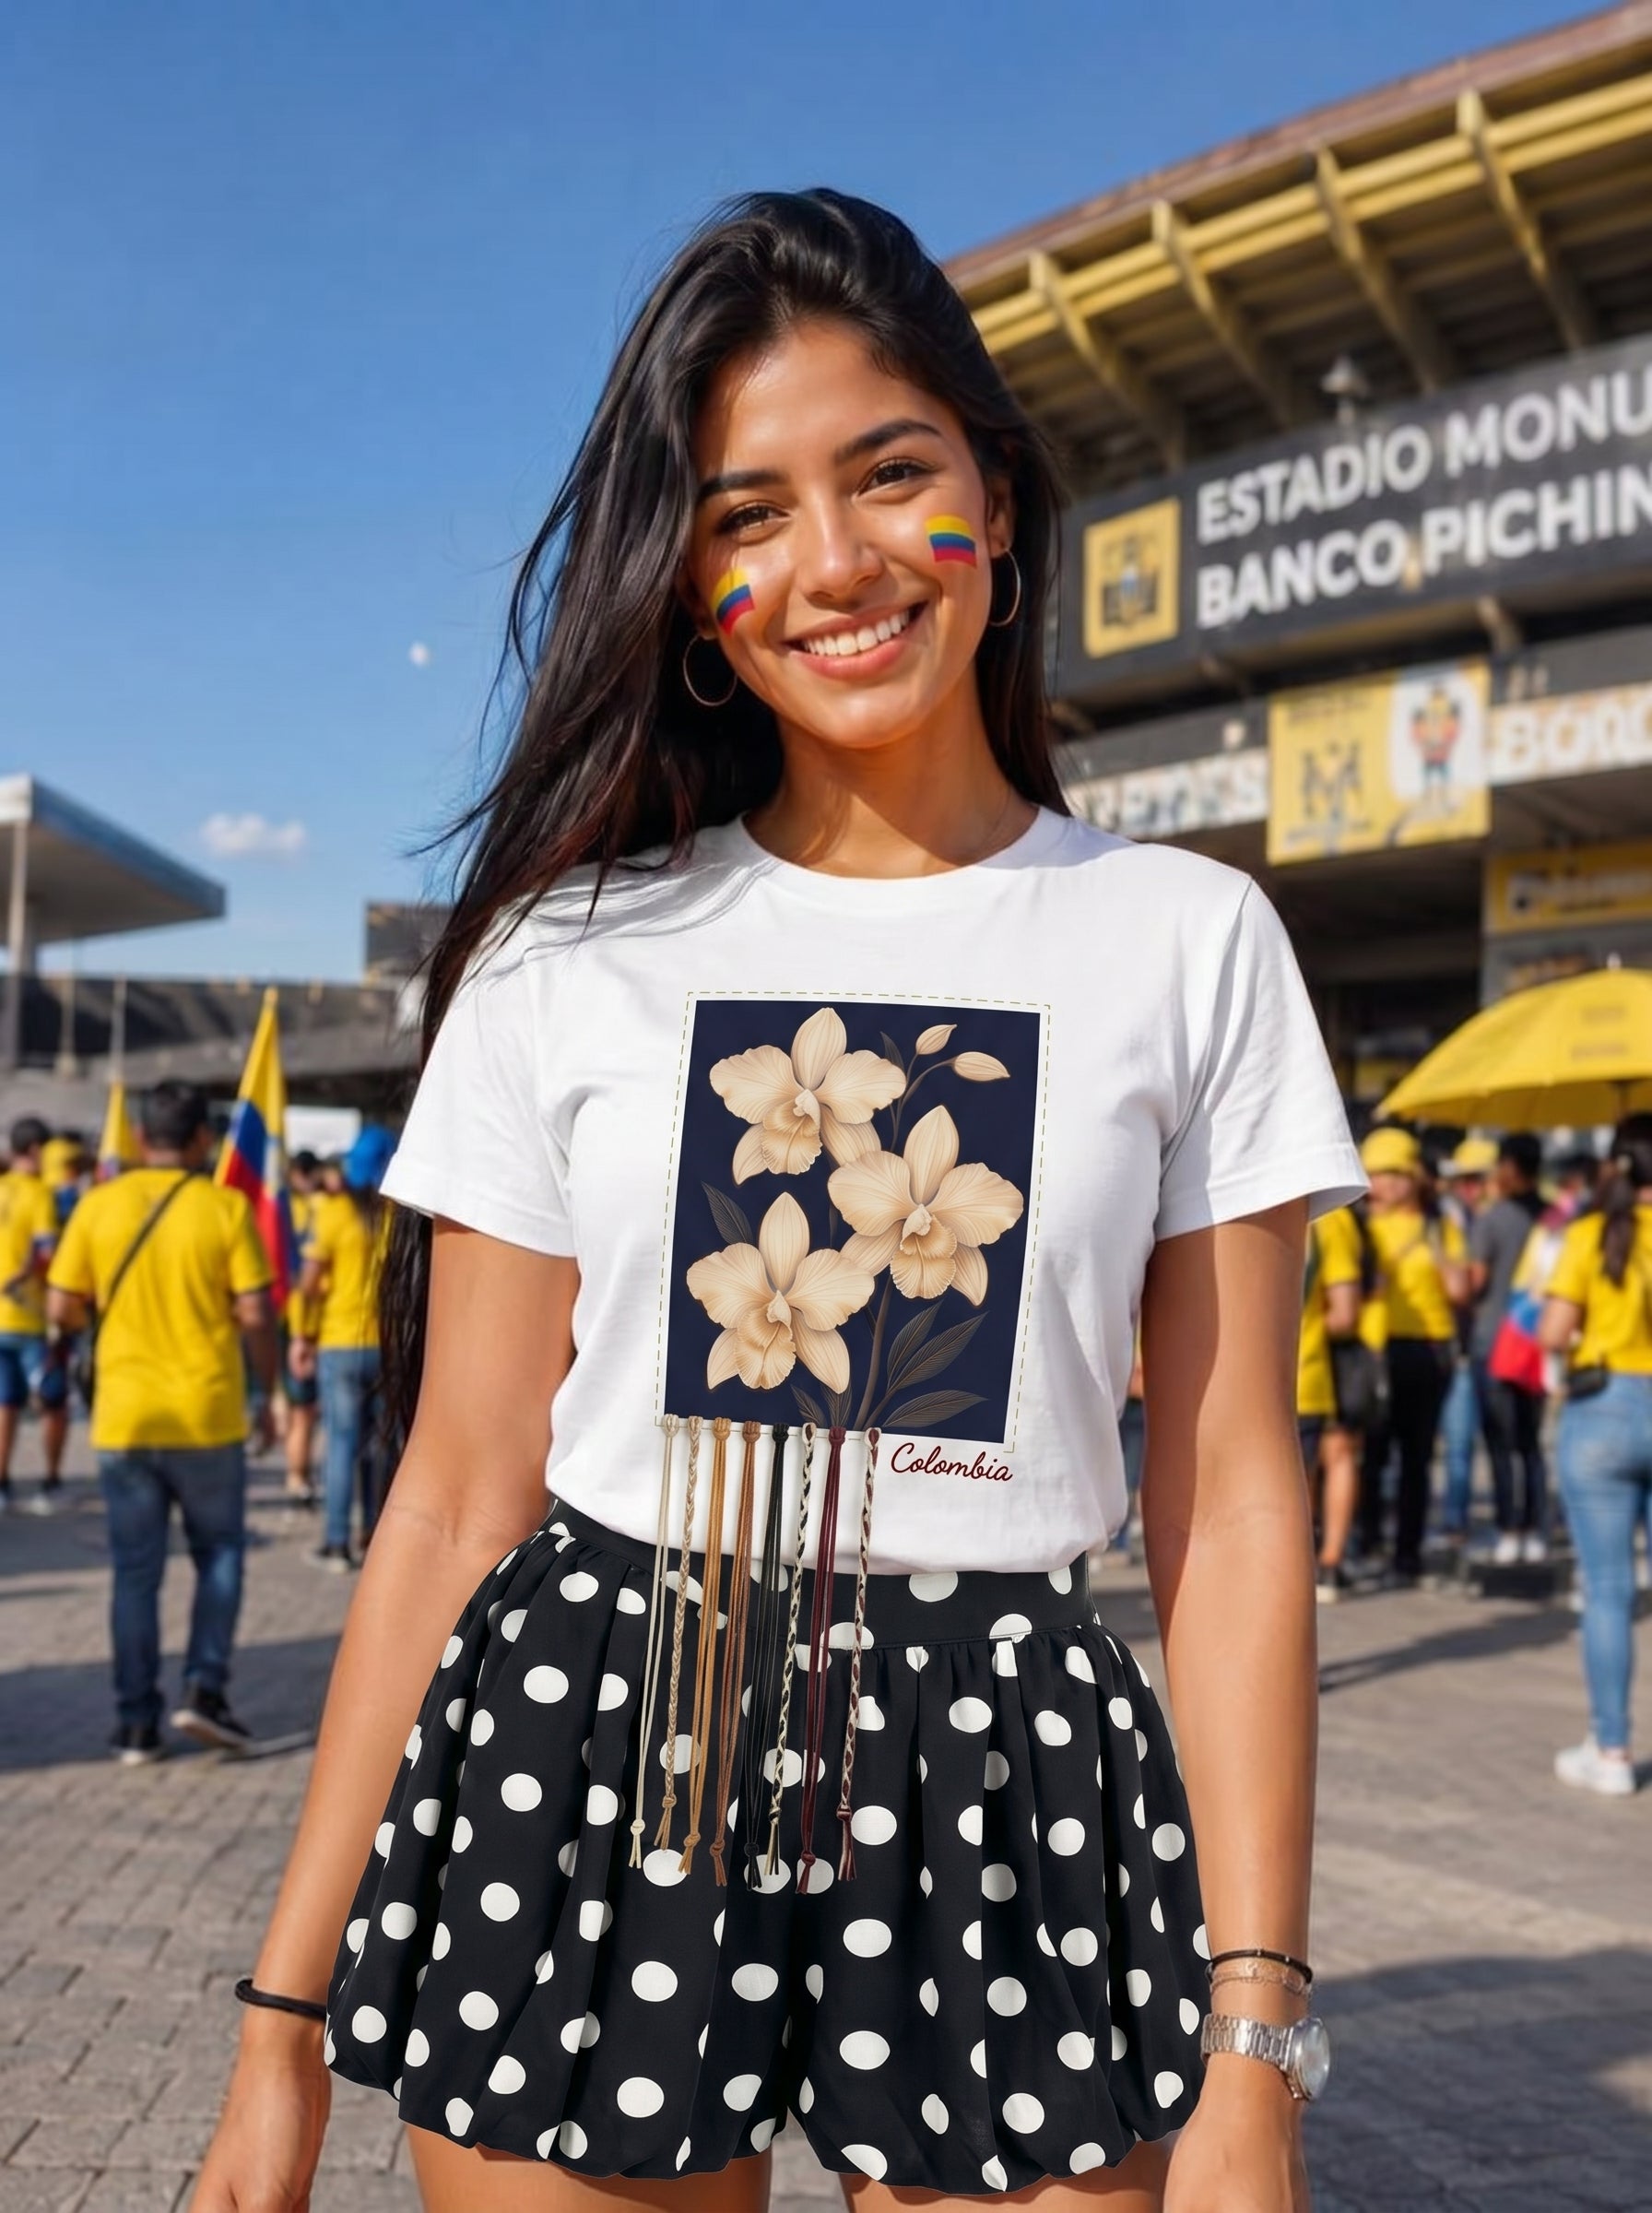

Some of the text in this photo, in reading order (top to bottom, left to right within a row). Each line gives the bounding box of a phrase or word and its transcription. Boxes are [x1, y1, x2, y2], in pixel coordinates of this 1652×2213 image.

[1198, 362, 1652, 544] ESTADIO MONU
[1198, 520, 1408, 630] BANCO
[891, 1442, 1014, 1482] Colombia
